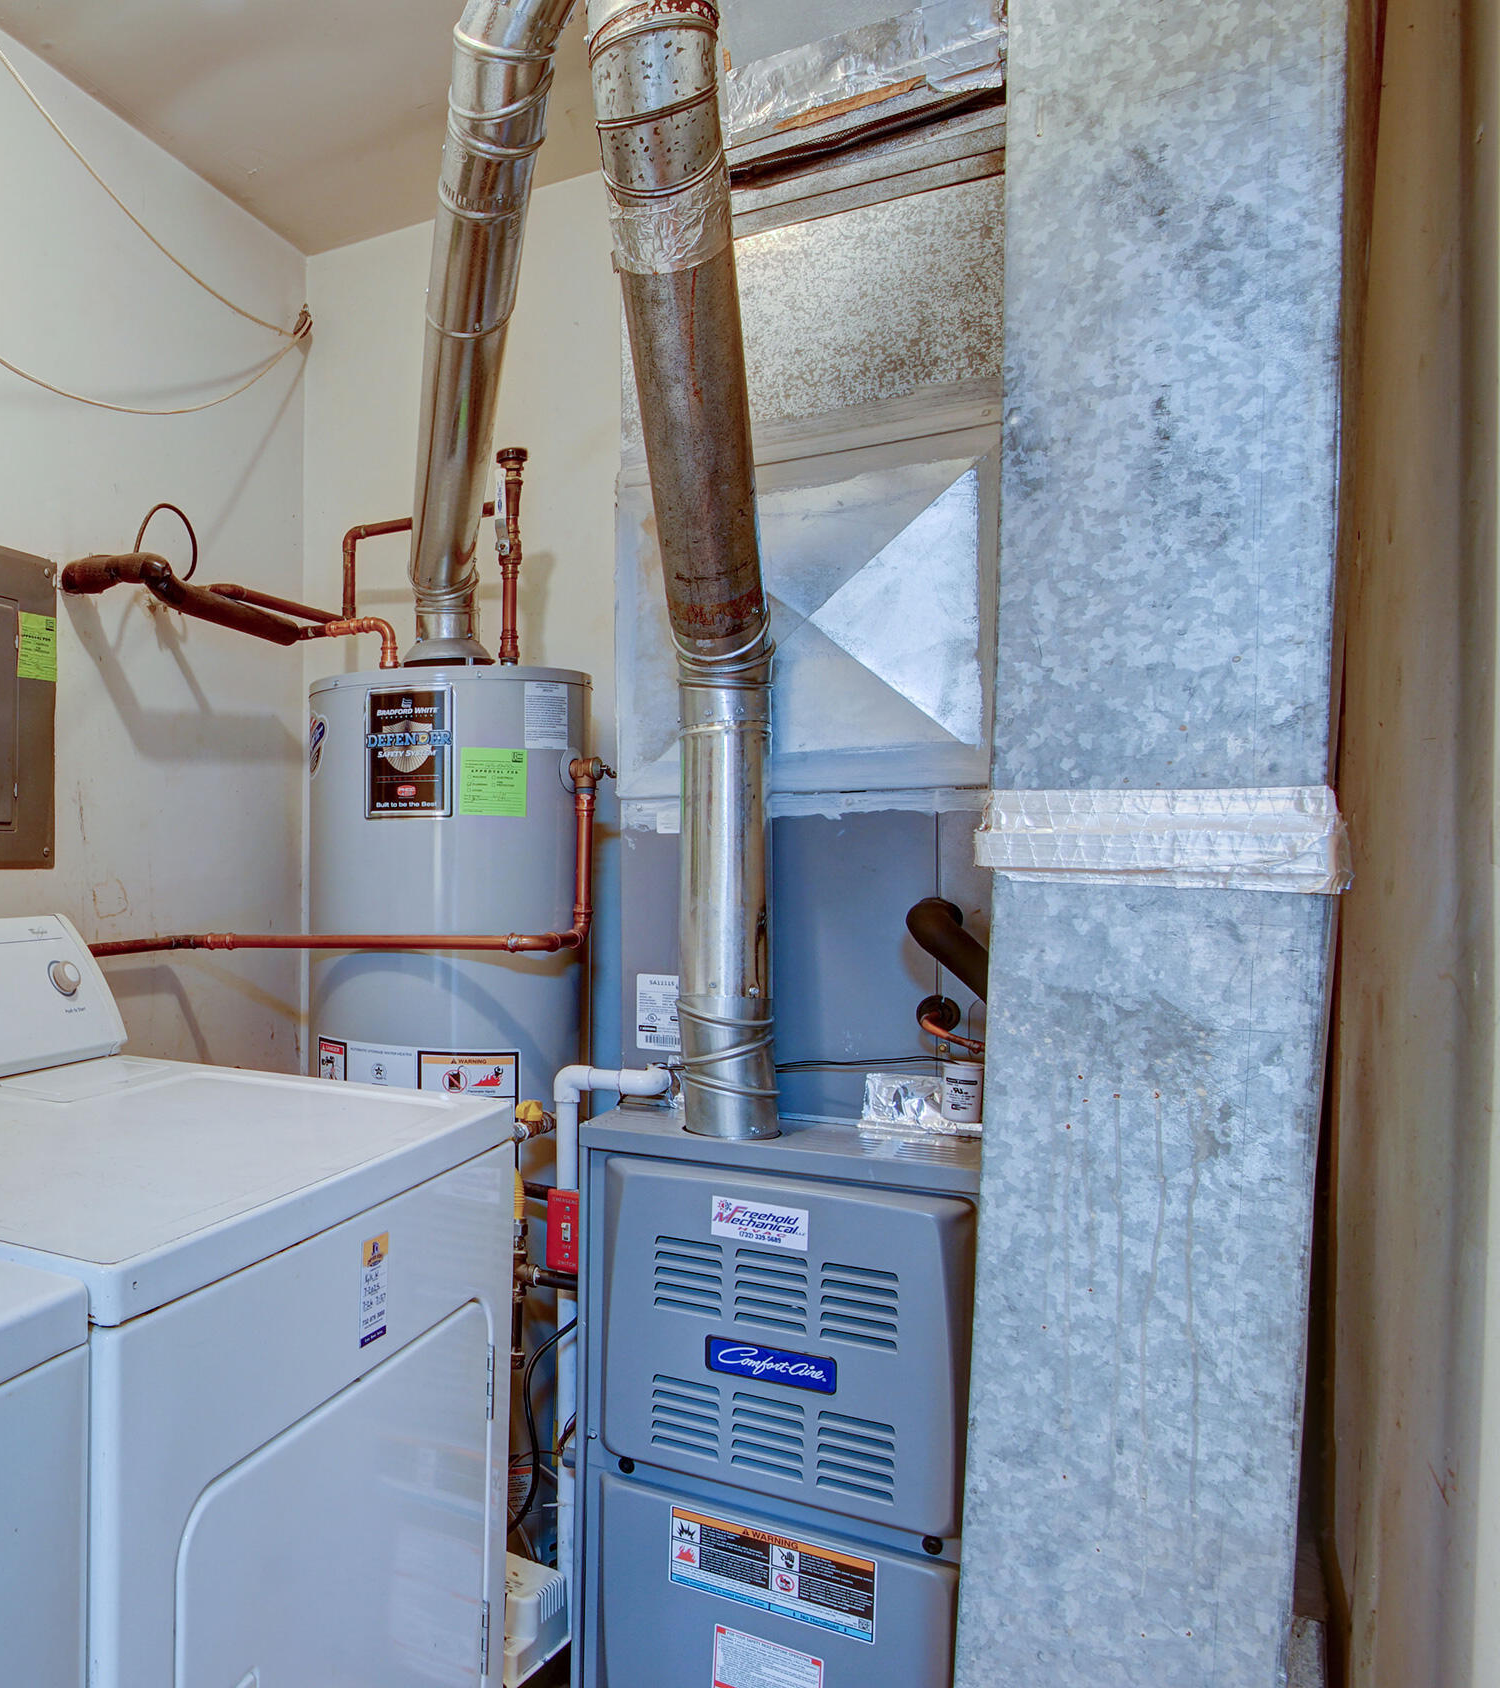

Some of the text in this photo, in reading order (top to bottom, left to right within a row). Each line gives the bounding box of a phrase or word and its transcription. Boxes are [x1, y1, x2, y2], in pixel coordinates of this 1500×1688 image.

[376, 706, 440, 716] BRADFORD WHITE
[367, 730, 452, 748] DEFENDER
[377, 749, 438, 758] SAFETY SYSTEM
[713, 1212, 799, 1234] Mechanical
[726, 1206, 799, 1225] Freehold
[717, 1346, 824, 1380] Comfort-Aire
[751, 1530, 799, 1550] WARNING
